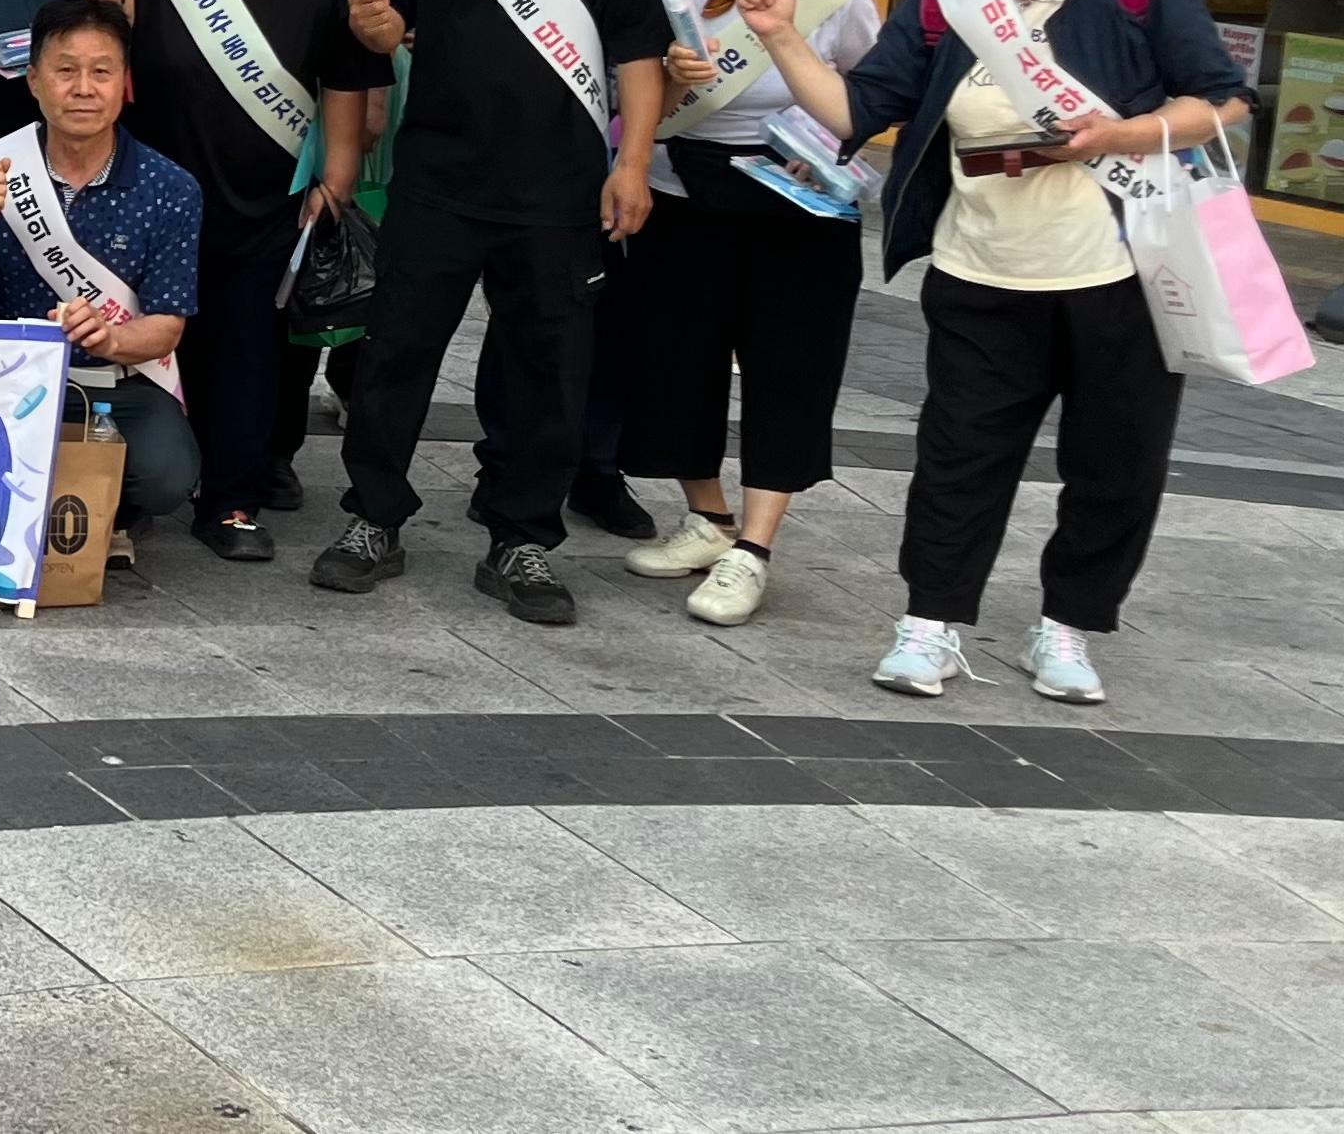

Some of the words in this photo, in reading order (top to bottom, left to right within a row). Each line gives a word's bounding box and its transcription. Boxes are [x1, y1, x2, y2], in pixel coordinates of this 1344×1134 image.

[532, 20, 605, 114] 단단하게!
[6, 172, 52, 243] 한번의
[42, 245, 103, 304] 호기심
